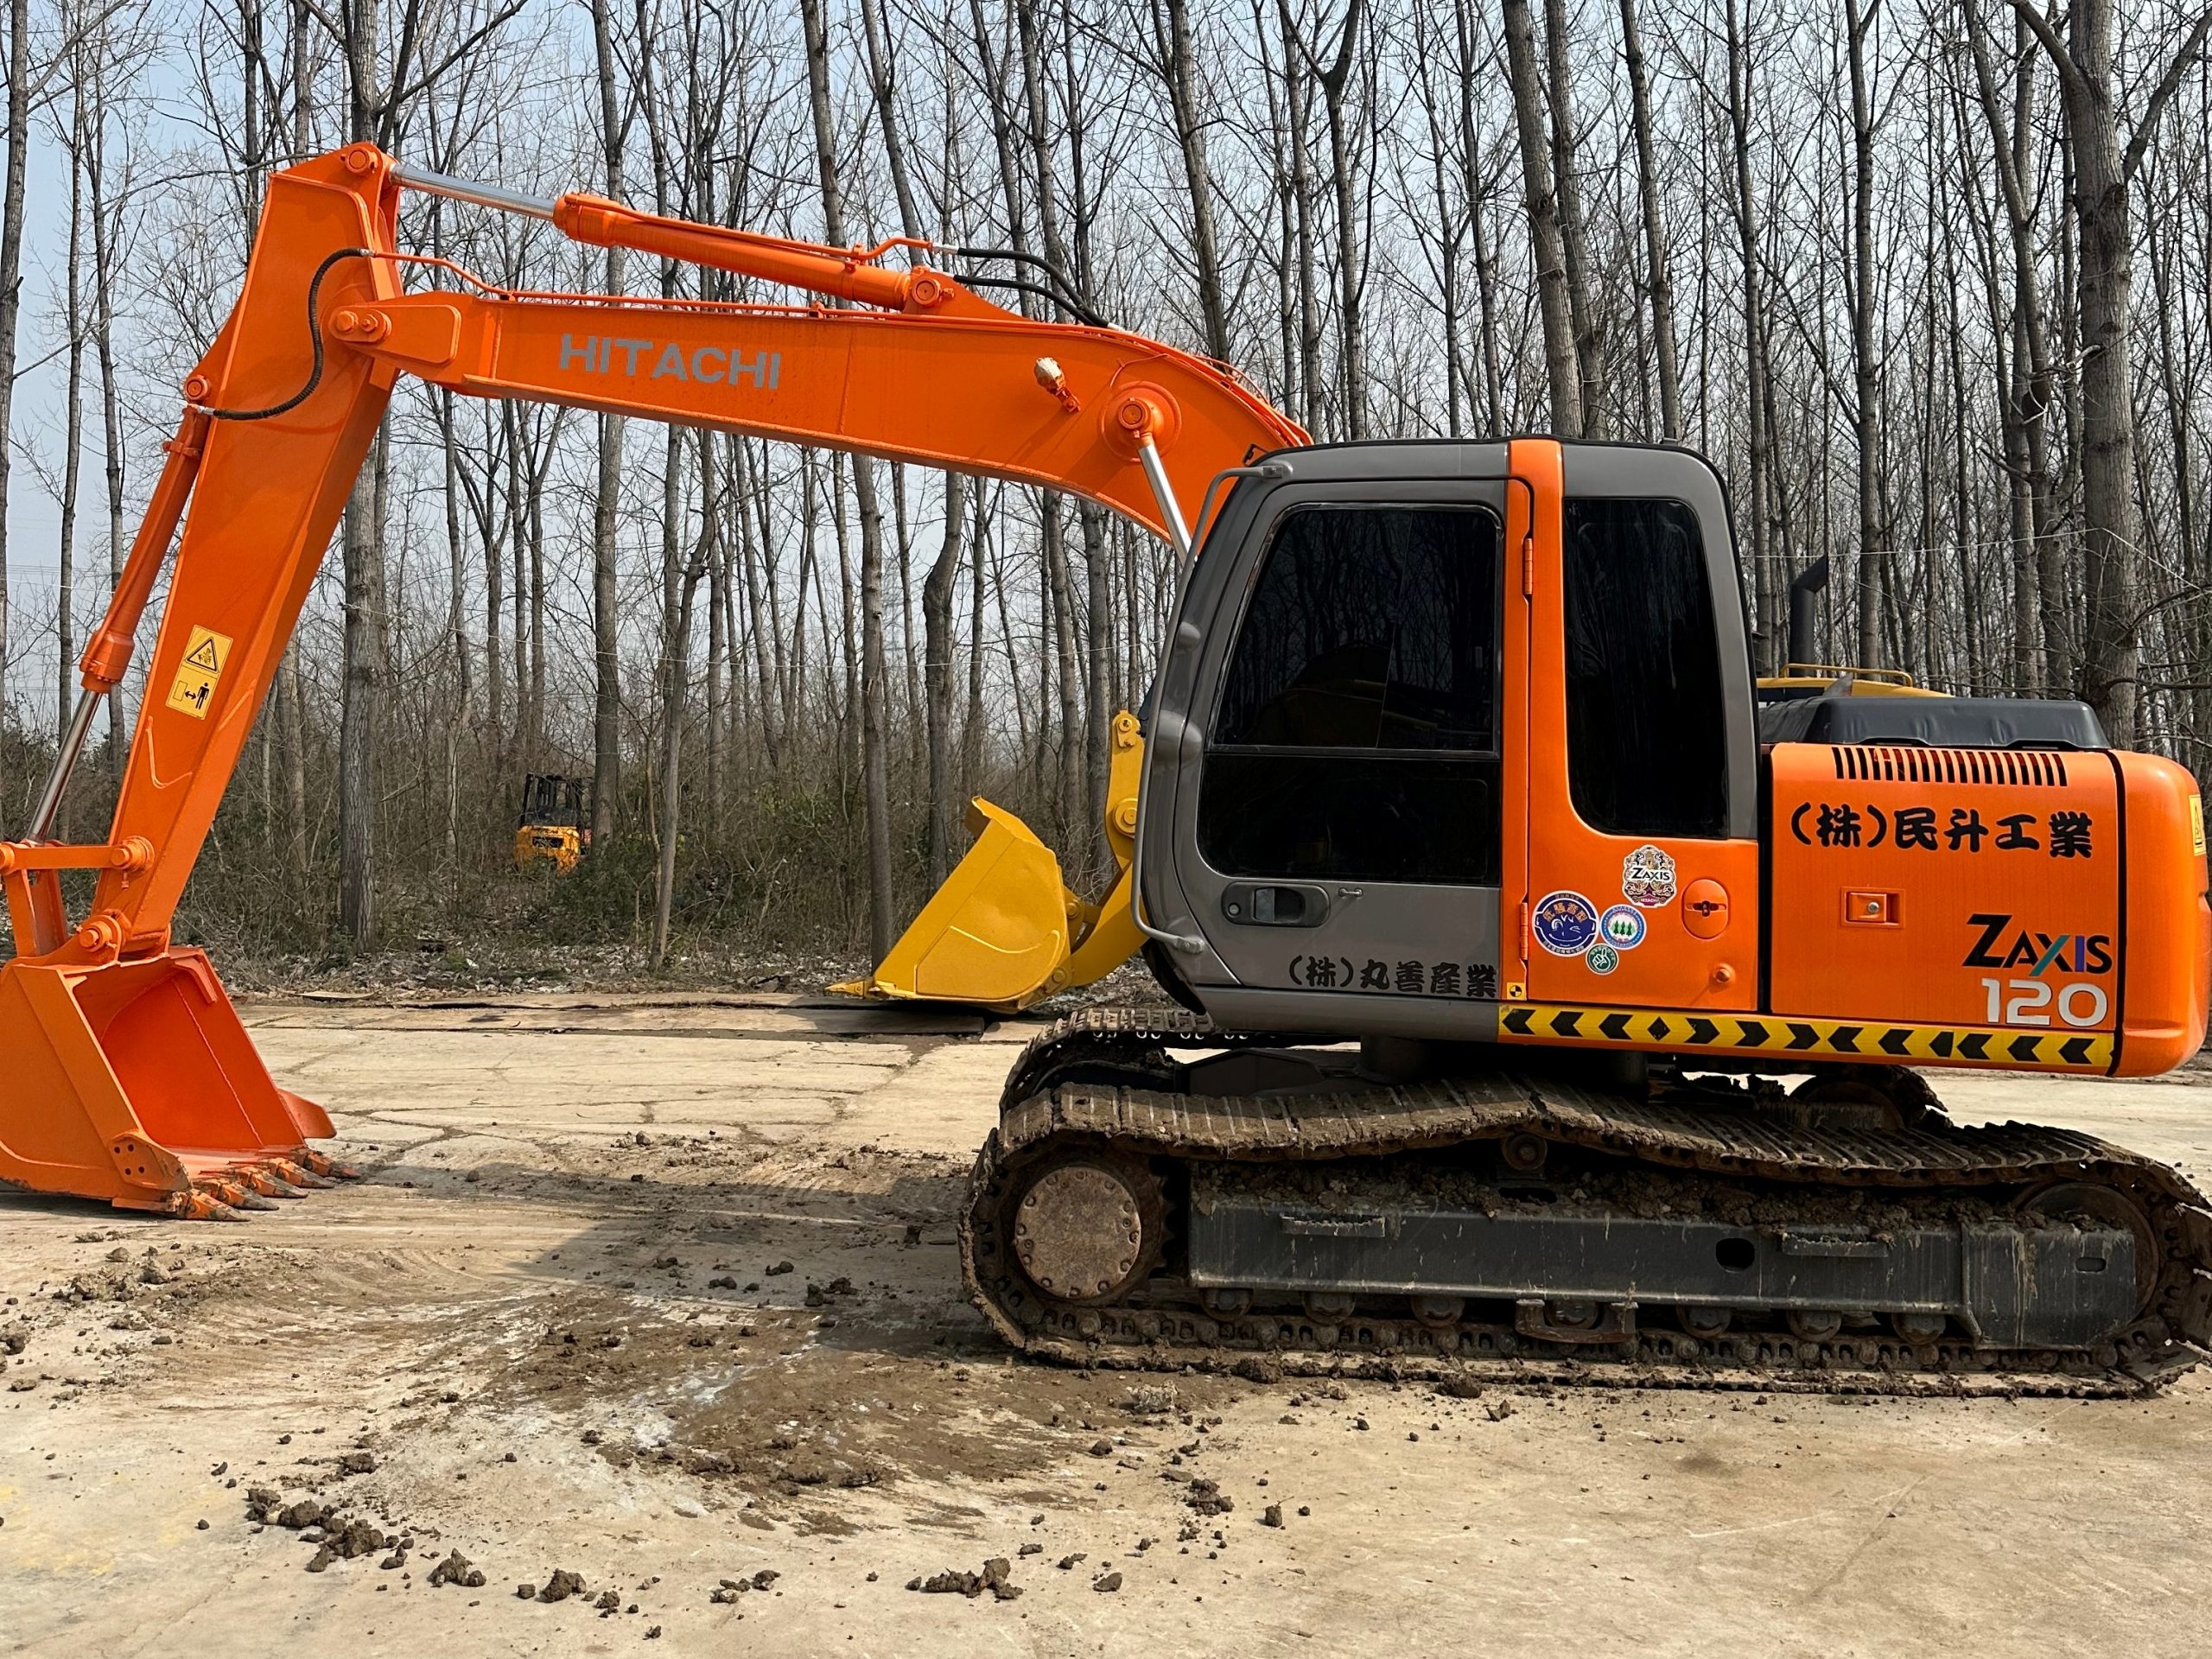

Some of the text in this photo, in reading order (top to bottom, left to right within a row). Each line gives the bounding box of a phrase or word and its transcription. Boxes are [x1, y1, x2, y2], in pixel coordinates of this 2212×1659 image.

[559, 333, 781, 390] HITACHI
[1631, 868, 1670, 880] ZAXIS
[1961, 913, 2113, 976] ZAXIS
[1288, 955, 1497, 998] (株)丸善産業
[1981, 978, 2108, 1027] 120
